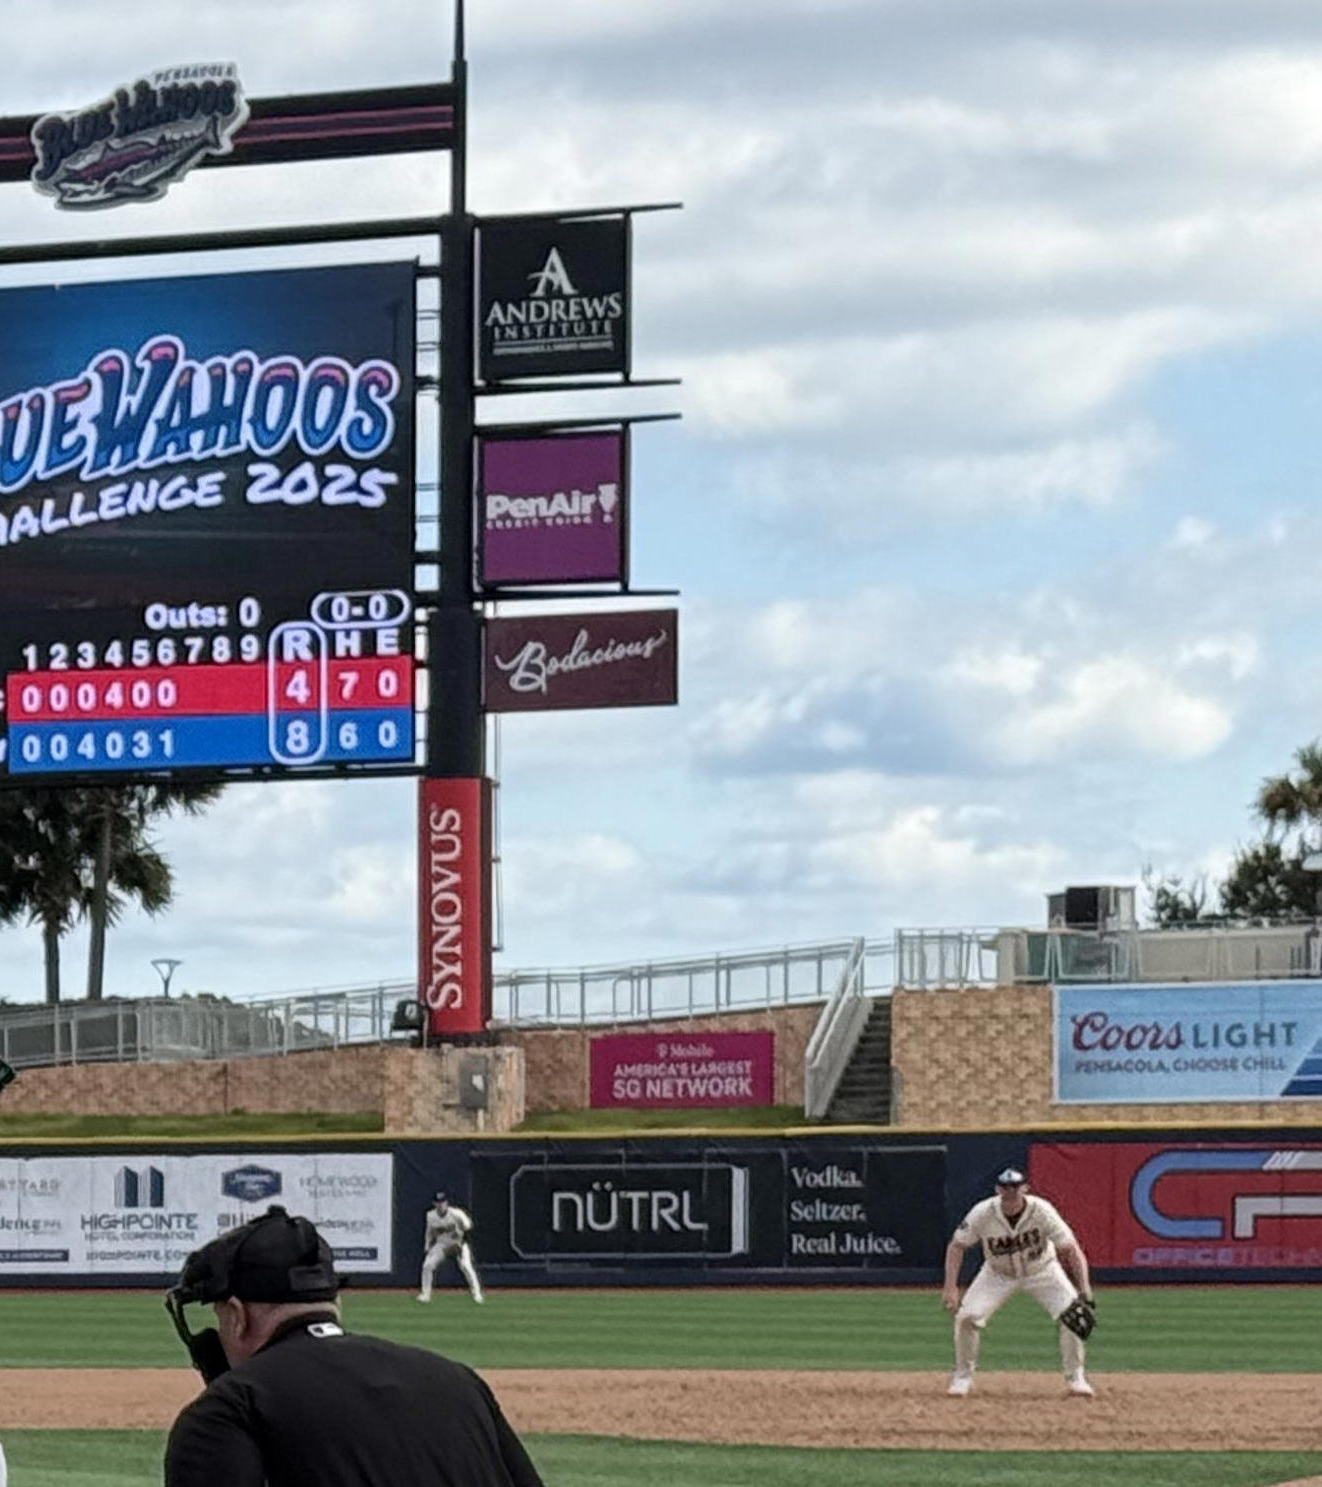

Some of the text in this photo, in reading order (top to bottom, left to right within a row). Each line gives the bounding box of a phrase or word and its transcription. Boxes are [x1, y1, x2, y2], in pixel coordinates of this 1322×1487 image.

[485, 291, 623, 326] ANDREWS
[493, 319, 614, 340] INSTITUTE
[246, 461, 399, 508] 2025
[144, 597, 260, 630] Outs: 0
[494, 627, 667, 695] Bodacious
[427, 807, 463, 1010] SYNOVUS
[1070, 1011, 1298, 1051] Coors LIGHT
[645, 1075, 753, 1099] NETWORK
[791, 1166, 863, 1188] Vodka.
[80, 1213, 198, 1231] HIGHPOINTE
[791, 1202, 865, 1222] Seltzer.
[791, 1235, 901, 1254] Real Juice.
